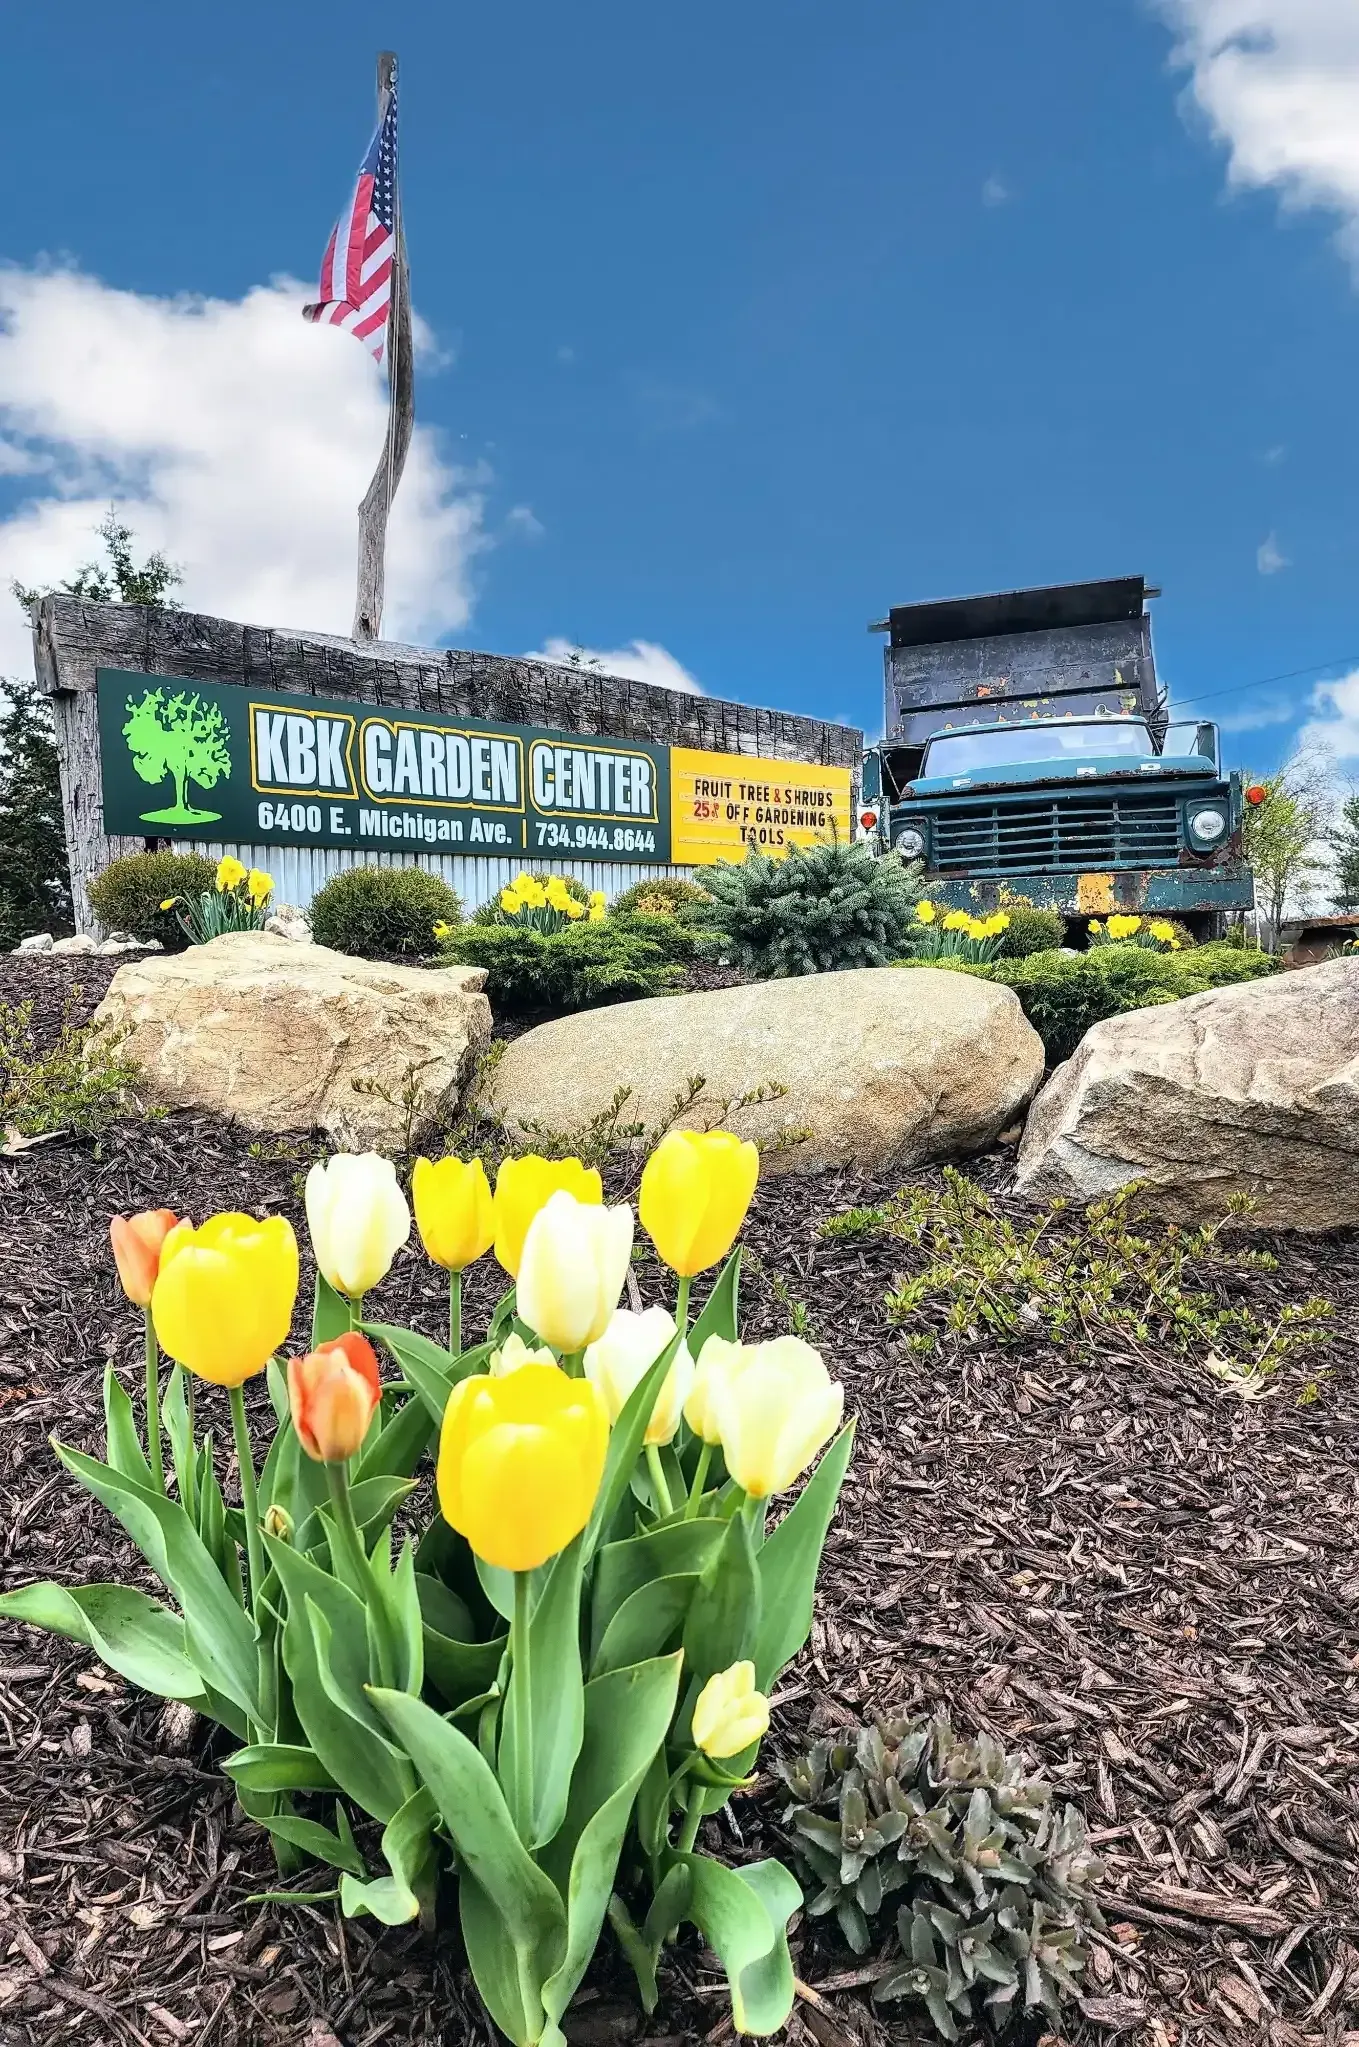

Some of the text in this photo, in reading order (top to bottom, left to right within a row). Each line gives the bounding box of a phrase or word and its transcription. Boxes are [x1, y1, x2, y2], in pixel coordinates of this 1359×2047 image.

[255, 711, 651, 815] KBK GARDEN CENTER
[694, 778, 833, 807] FRUIT TREE & SHRUBS
[258, 801, 656, 853] 6400 E. Michigan Ave. 734.944.8644
[726, 802, 750, 823] OFF
[756, 806, 826, 827] GARDENING
